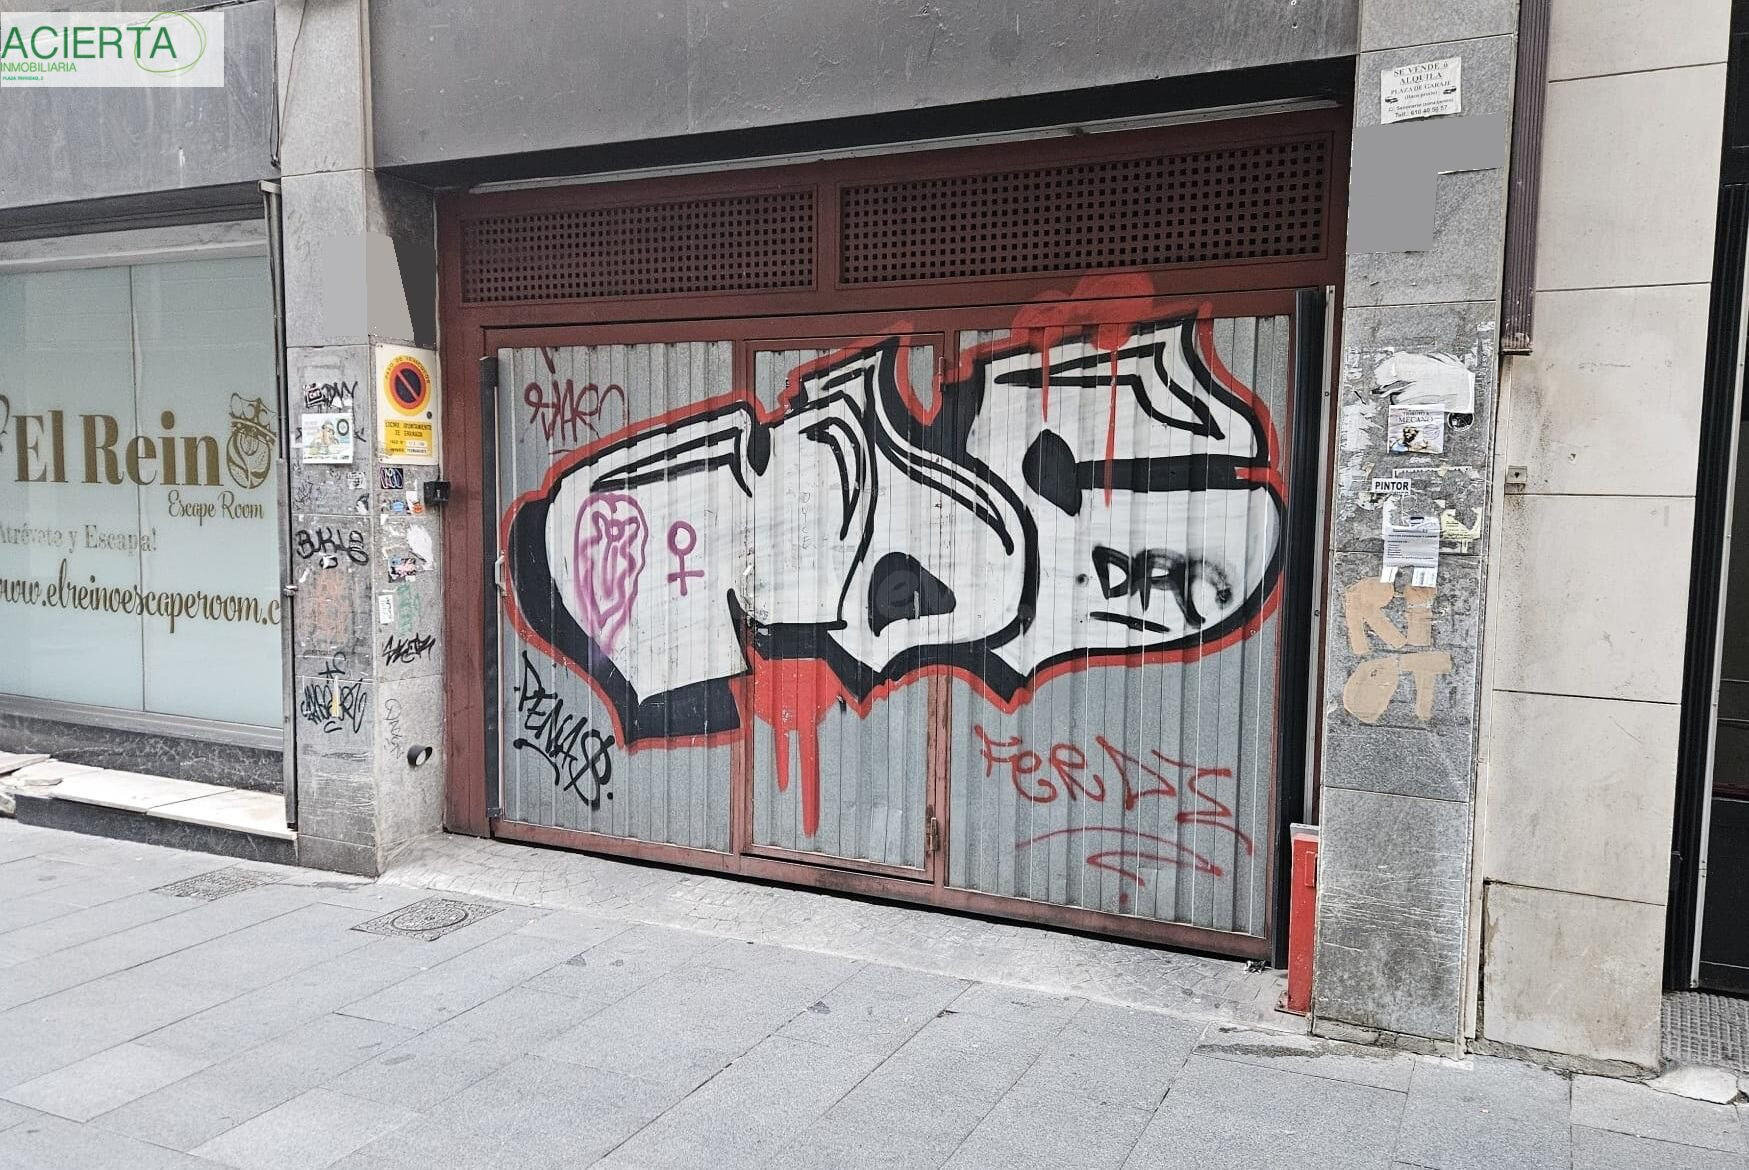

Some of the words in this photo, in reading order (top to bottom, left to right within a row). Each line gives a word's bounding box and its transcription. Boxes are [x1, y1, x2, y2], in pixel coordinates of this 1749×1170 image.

[1408, 63, 1440, 74] VENDE
[1400, 72, 1443, 85] ALQUILA
[1424, 80, 1452, 90] GARAJE
[12, 410, 69, 484] El
[1375, 481, 1409, 491] PINTOR
[168, 490, 217, 526] Escape
[218, 490, 264, 520] Room
[68, 529, 78, 554] y
